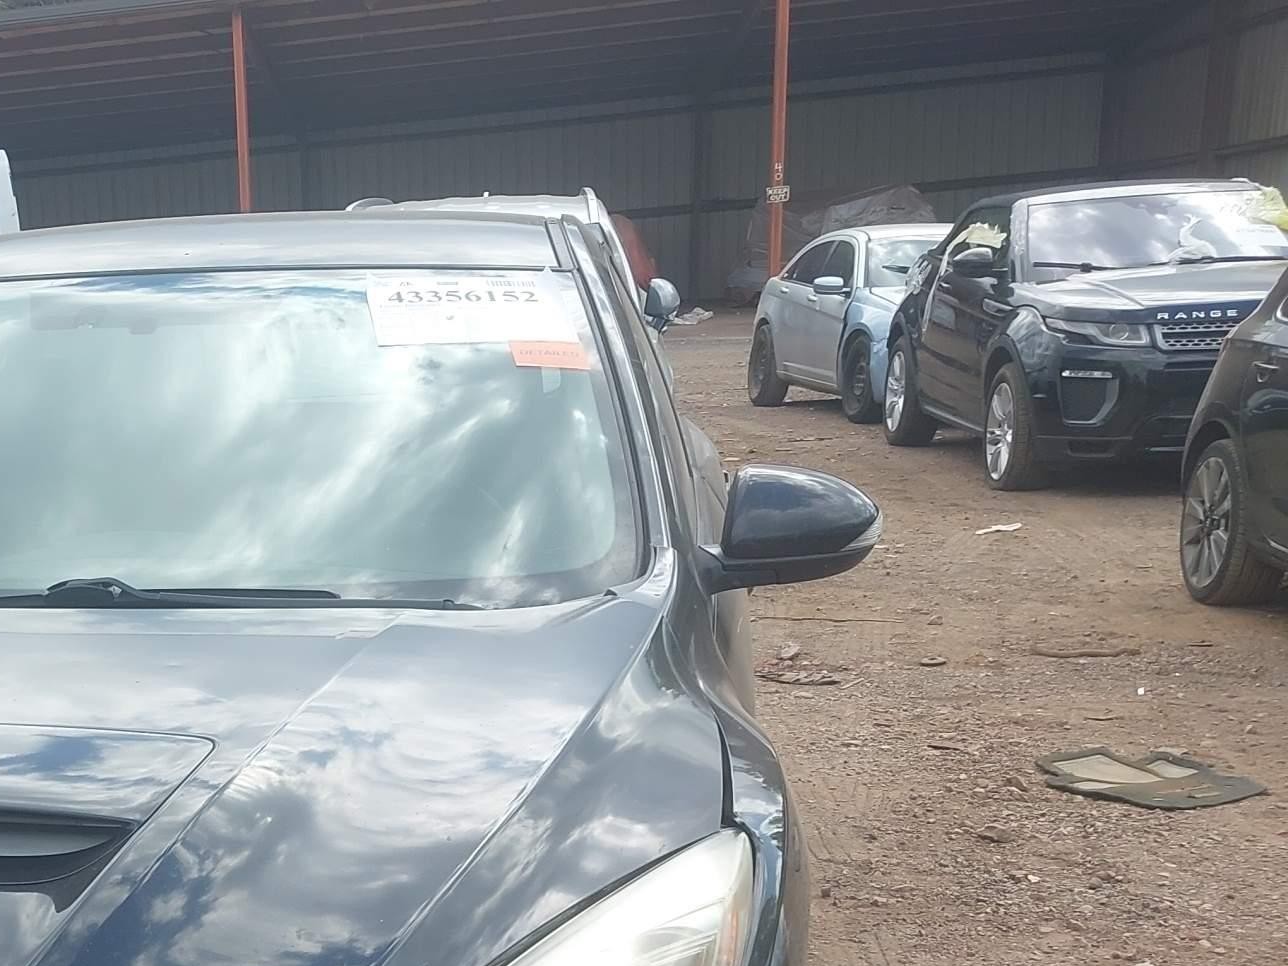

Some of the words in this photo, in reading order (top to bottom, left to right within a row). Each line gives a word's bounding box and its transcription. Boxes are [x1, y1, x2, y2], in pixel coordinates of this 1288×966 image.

[768, 187, 788, 195] KEEP
[387, 290, 540, 304] 43356152
[1157, 309, 1239, 320] RANGE
